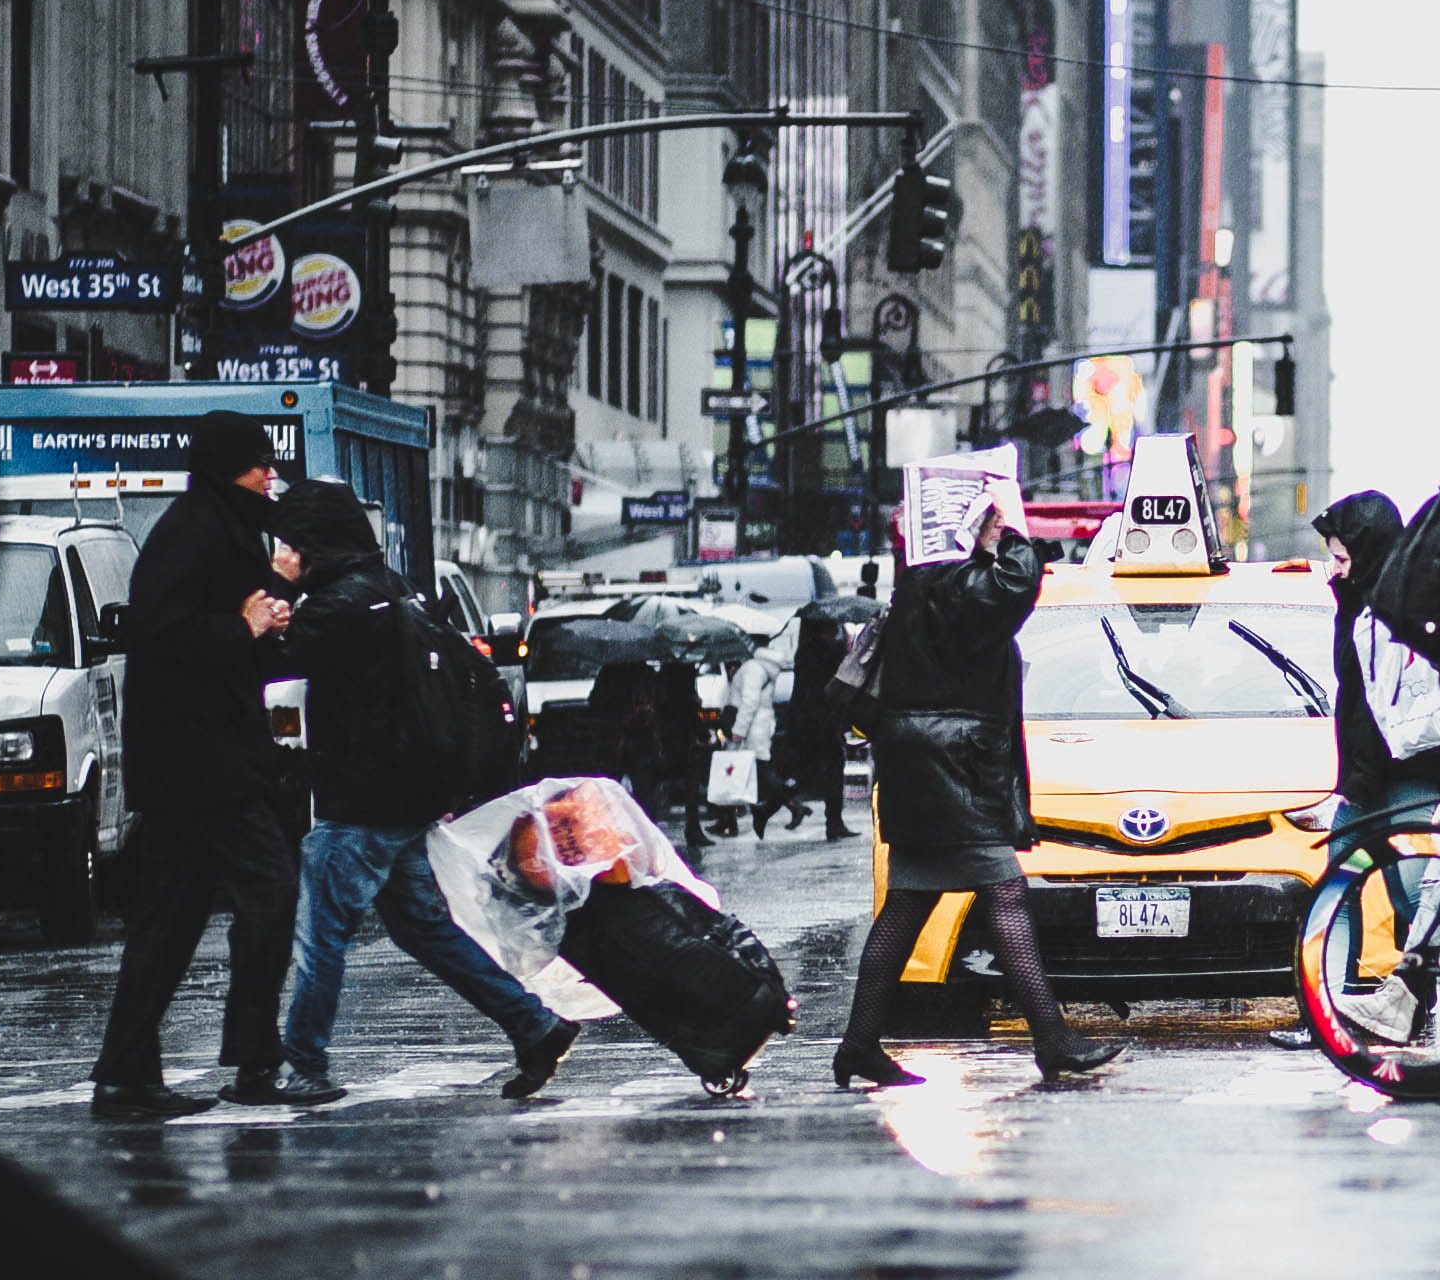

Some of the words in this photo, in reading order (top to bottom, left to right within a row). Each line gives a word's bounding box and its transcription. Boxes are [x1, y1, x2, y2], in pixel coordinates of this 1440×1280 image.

[22, 273, 80, 299] West
[87, 273, 131, 299] 35th
[137, 273, 161, 299] St
[217, 357, 269, 381] West
[274, 357, 313, 381] 35th
[319, 357, 340, 380] St
[32, 433, 106, 450] EARTH'S
[111, 433, 170, 449] FINEST
[628, 504, 665, 519] West
[668, 503, 687, 519] 36
[1142, 498, 1186, 520] 8L47
